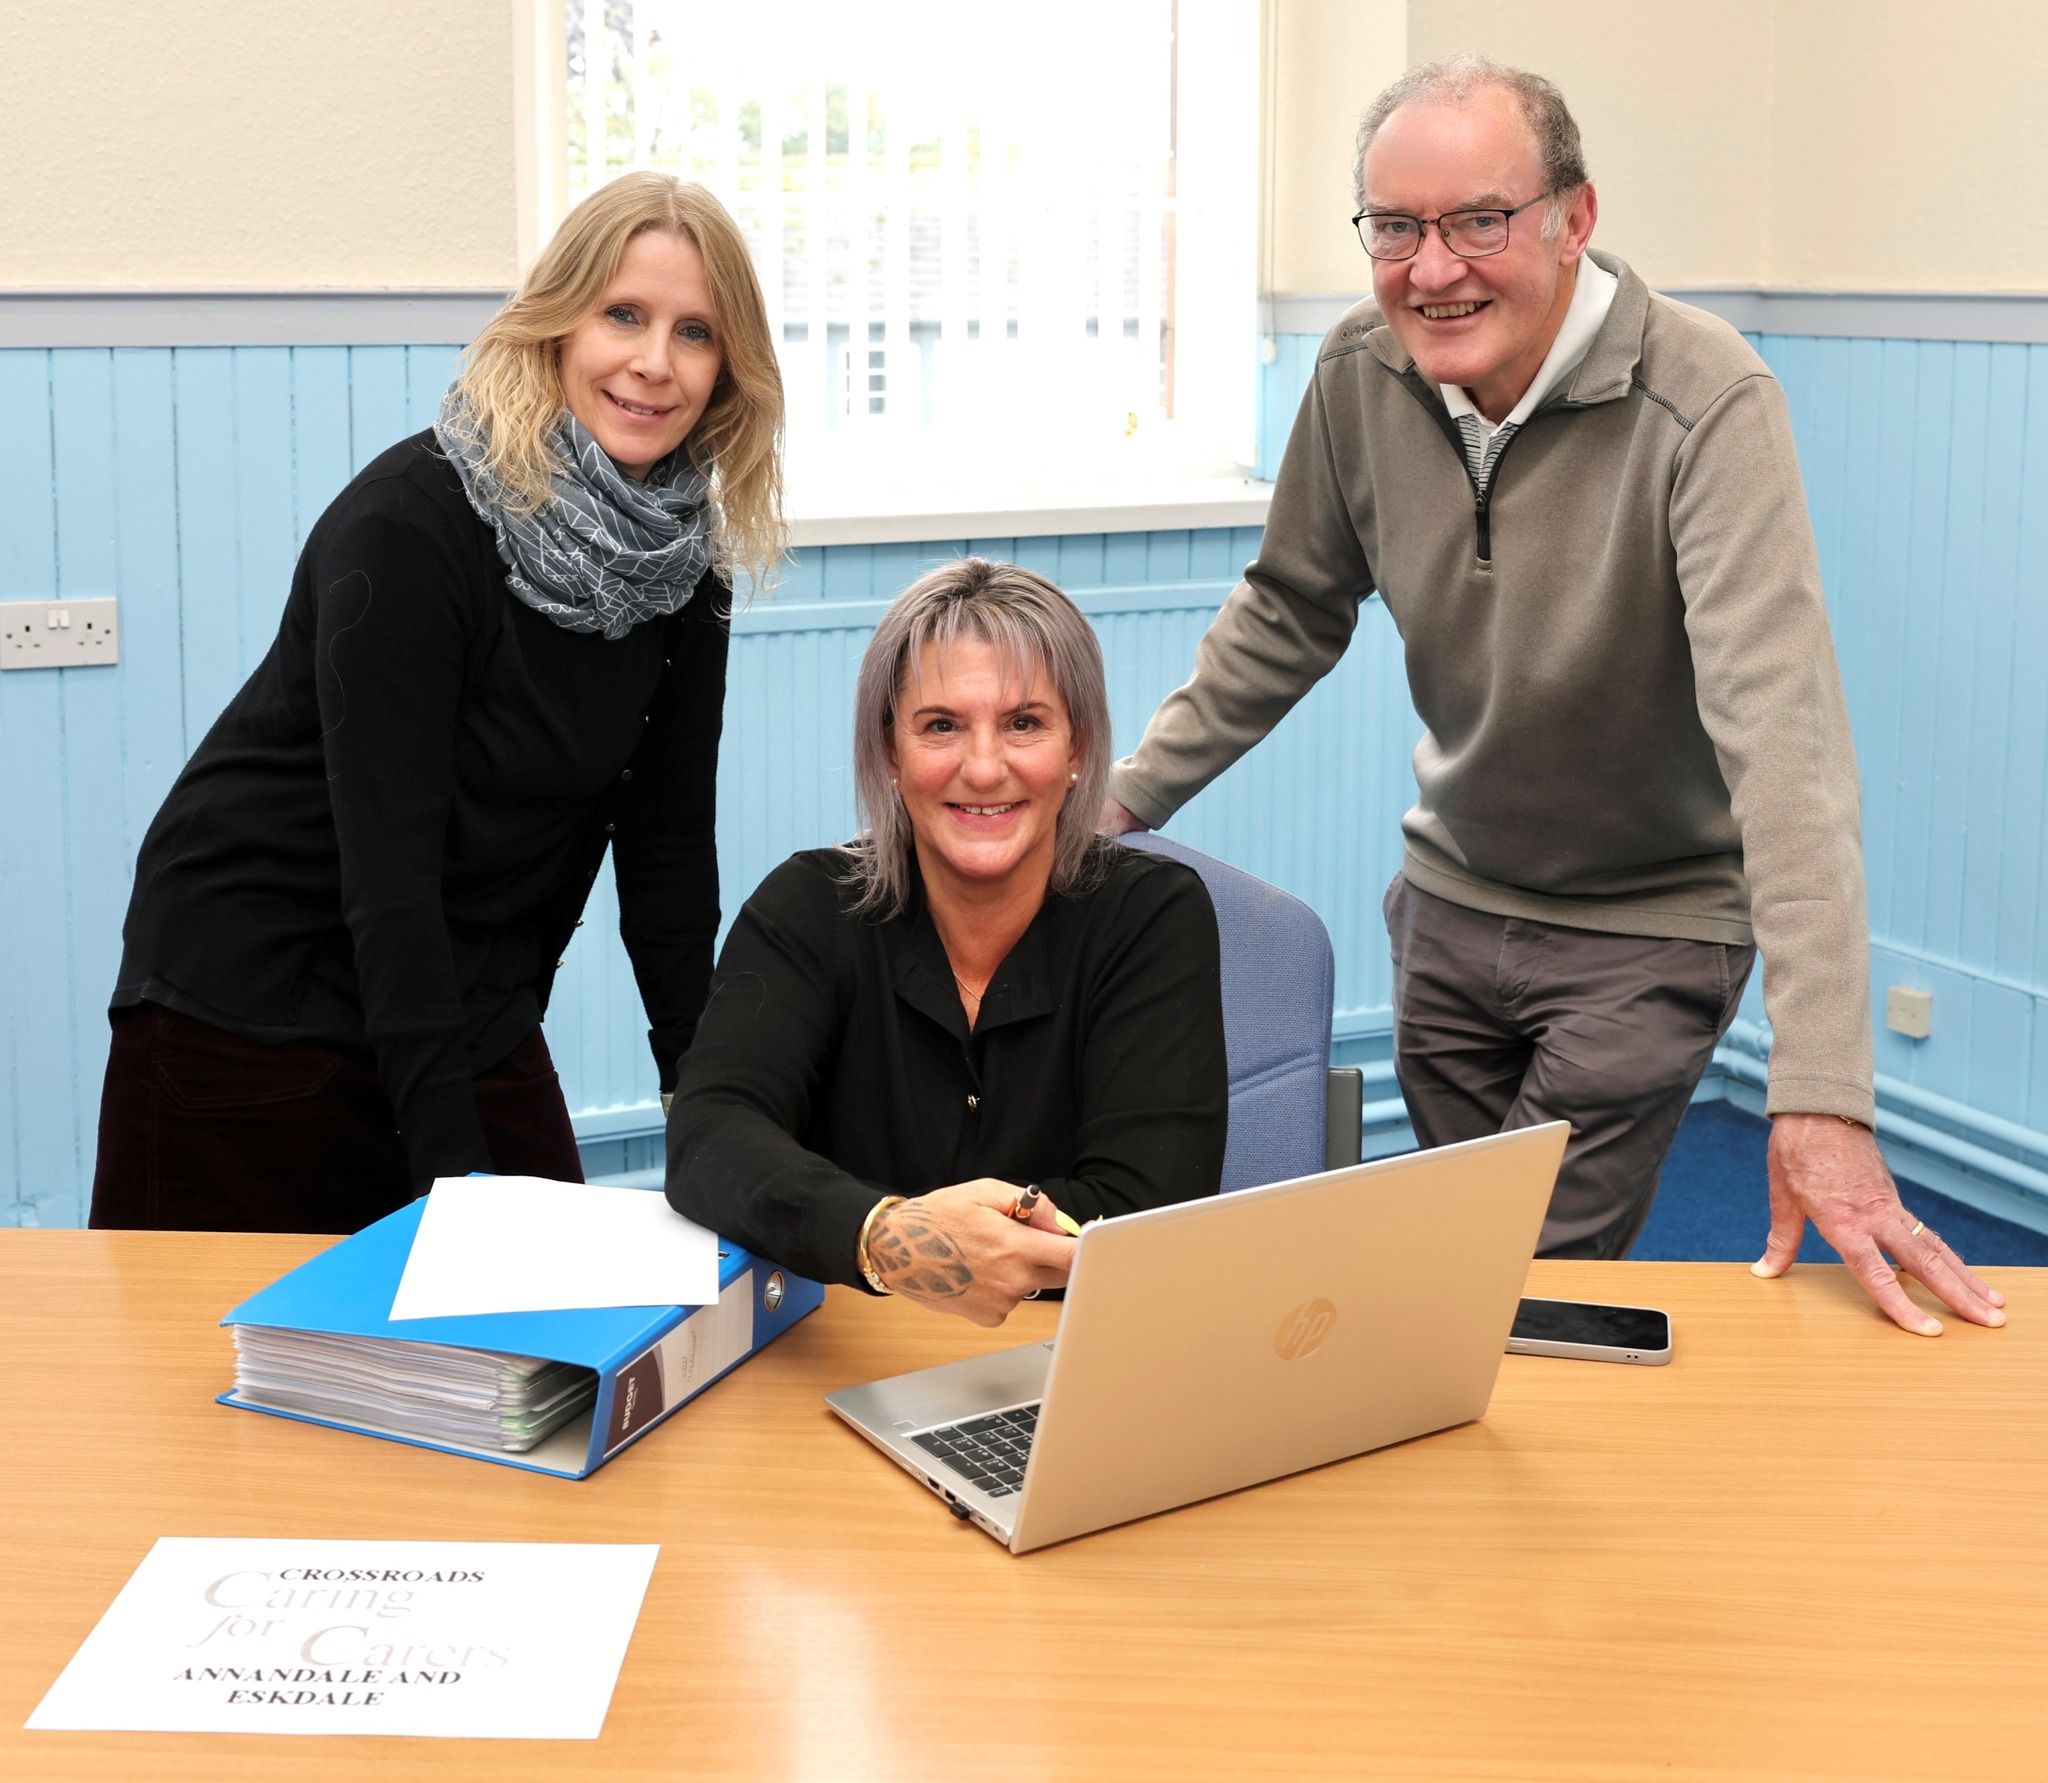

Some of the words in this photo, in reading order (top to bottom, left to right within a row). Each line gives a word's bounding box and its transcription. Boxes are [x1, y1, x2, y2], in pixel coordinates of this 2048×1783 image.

[1280, 1302, 1332, 1359] hp
[622, 1376, 636, 1430] BUDGET
[204, 1570, 418, 1618] Caring
[279, 1568, 485, 1583] CROSSROADS
[186, 1614, 286, 1648] for
[300, 1625, 511, 1668] Carers
[172, 1667, 383, 1684] ANNANDALE
[388, 1671, 461, 1685] AND
[226, 1689, 385, 1706] ESKDALE
